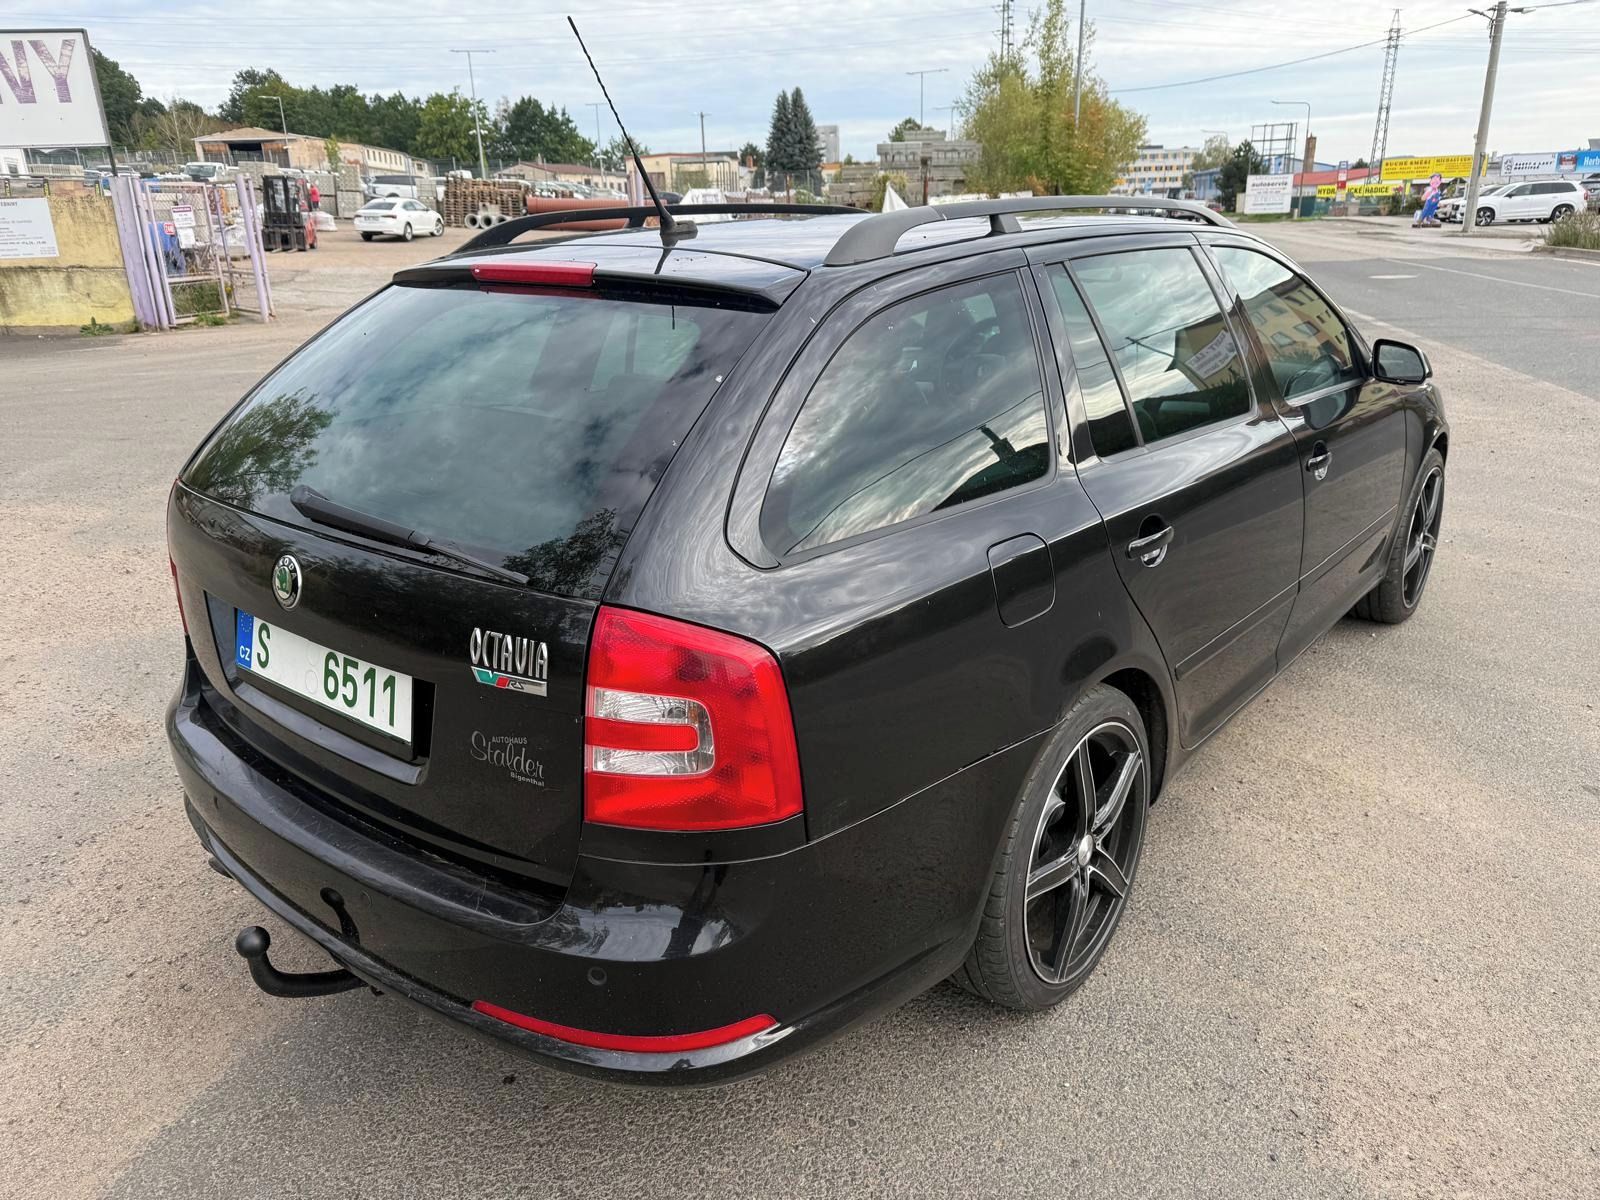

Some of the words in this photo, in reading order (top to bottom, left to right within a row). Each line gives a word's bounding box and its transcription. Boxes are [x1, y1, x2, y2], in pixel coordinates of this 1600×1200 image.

[239, 645, 251, 661] CZ
[256, 622, 271, 669] S
[323, 651, 396, 728] 6511
[470, 627, 548, 680] OCTAVIA
[470, 730, 545, 779] Stalder
[491, 735, 528, 745] AUTOHAUS
